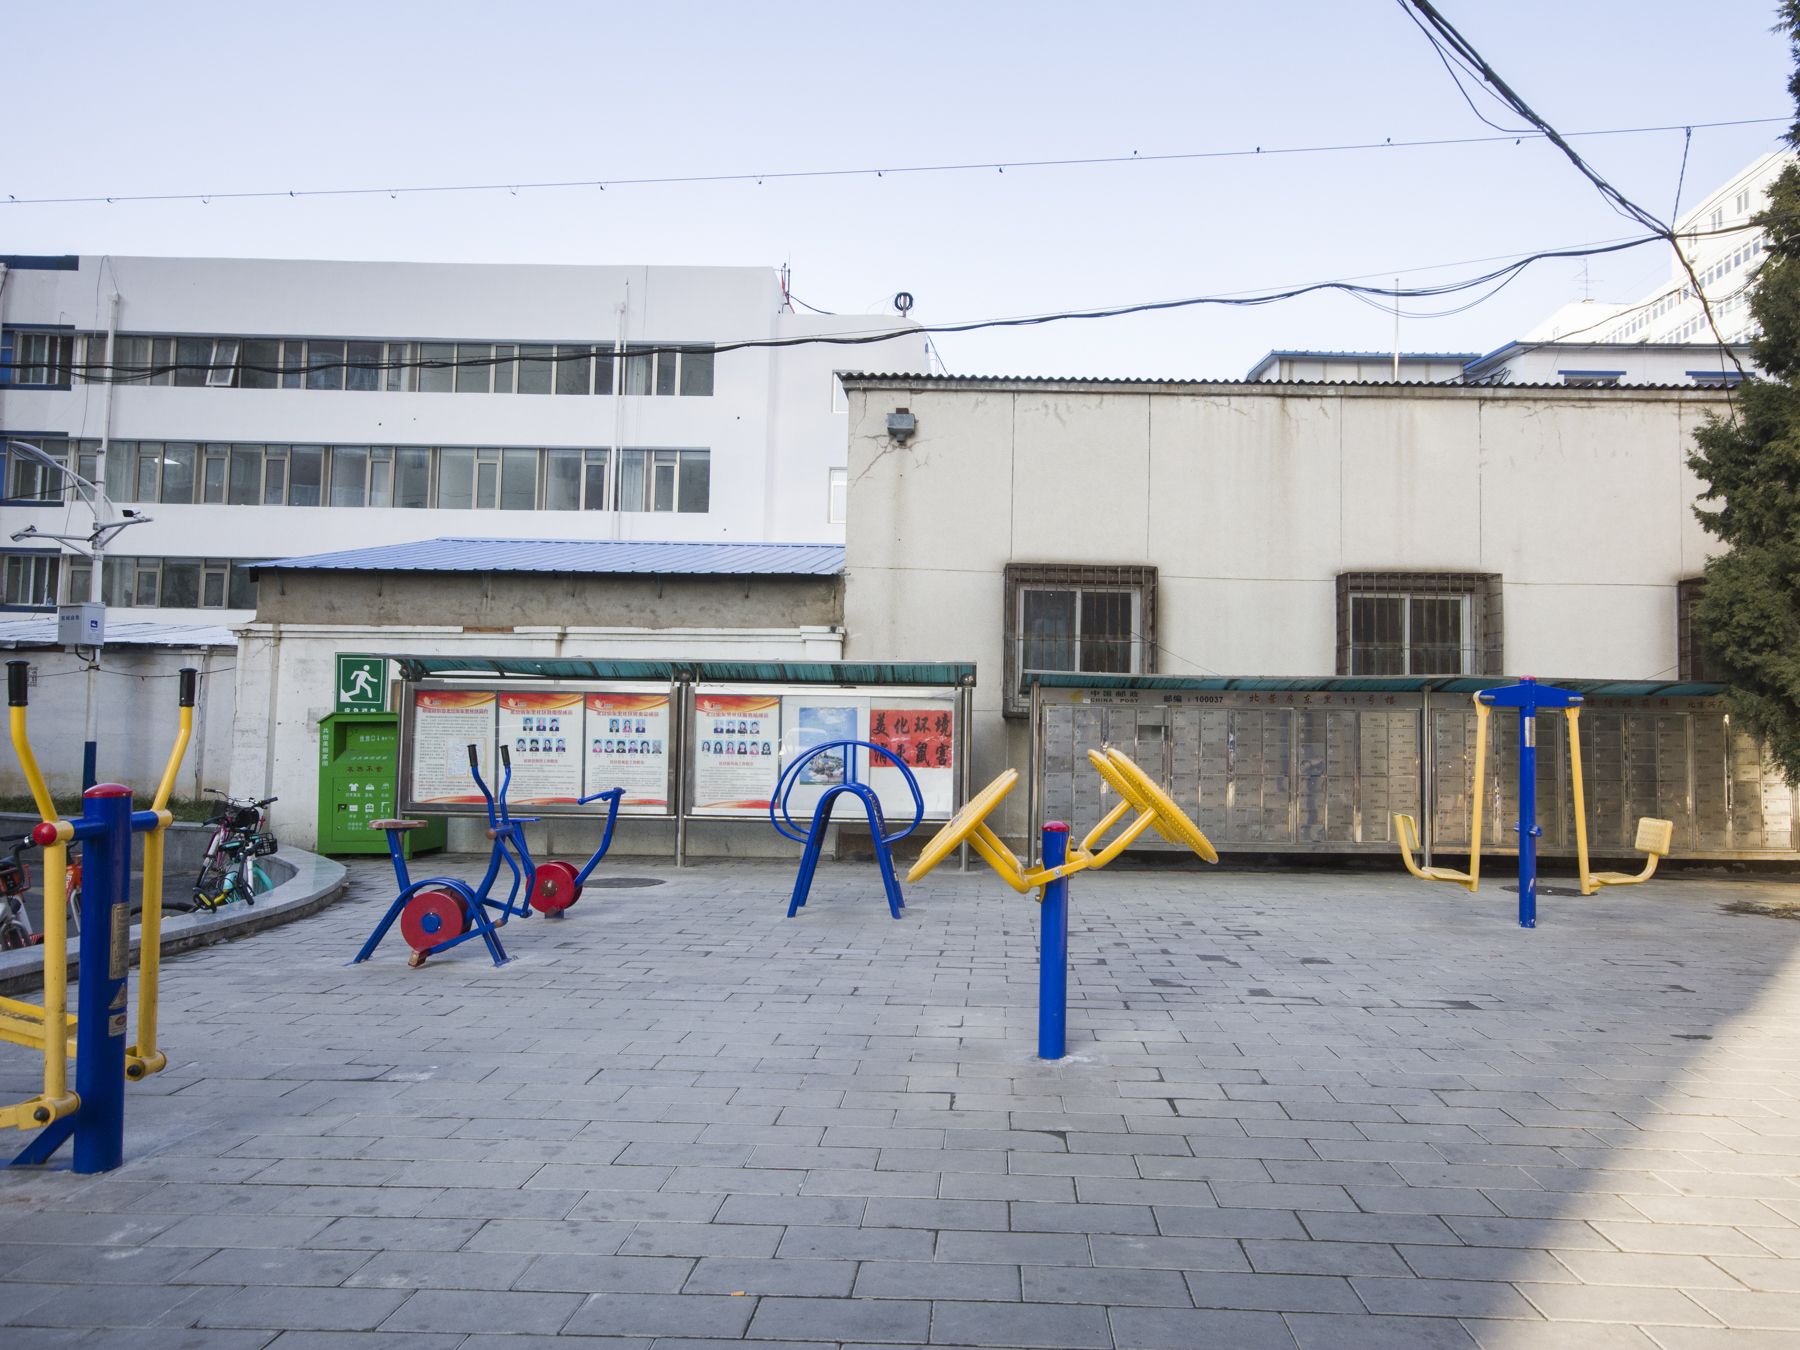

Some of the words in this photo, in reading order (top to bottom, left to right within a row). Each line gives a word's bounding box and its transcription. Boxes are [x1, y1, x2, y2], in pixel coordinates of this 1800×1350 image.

[1090, 690, 1138, 698] 中国邮政
[871, 711, 952, 738] 美化环境
